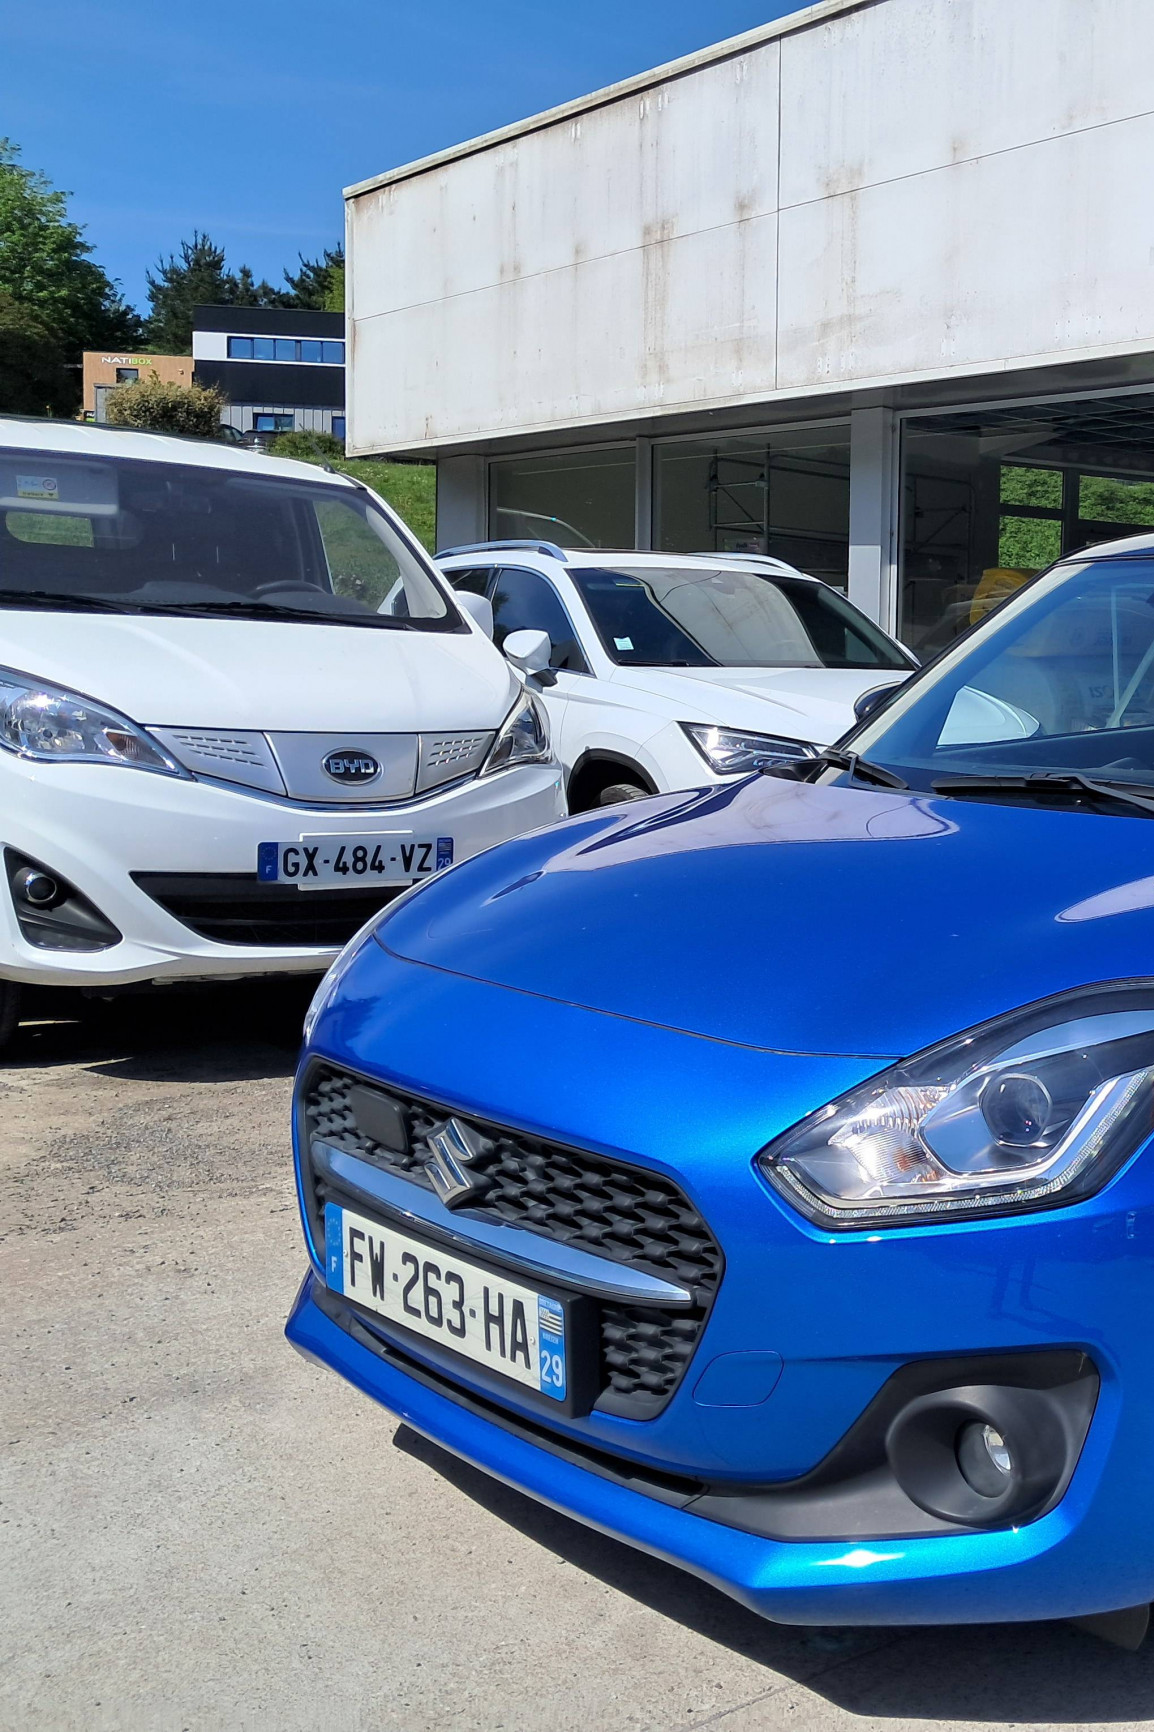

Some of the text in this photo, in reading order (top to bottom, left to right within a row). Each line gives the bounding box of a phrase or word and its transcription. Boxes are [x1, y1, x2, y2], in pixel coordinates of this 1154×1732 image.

[101, 356, 152, 366] NATIBOX
[329, 758, 375, 774] BYD
[282, 843, 433, 878] GX-484-VZ
[265, 865, 272, 875] F
[331, 1256, 337, 1272] F
[540, 1350, 563, 1387] 29
